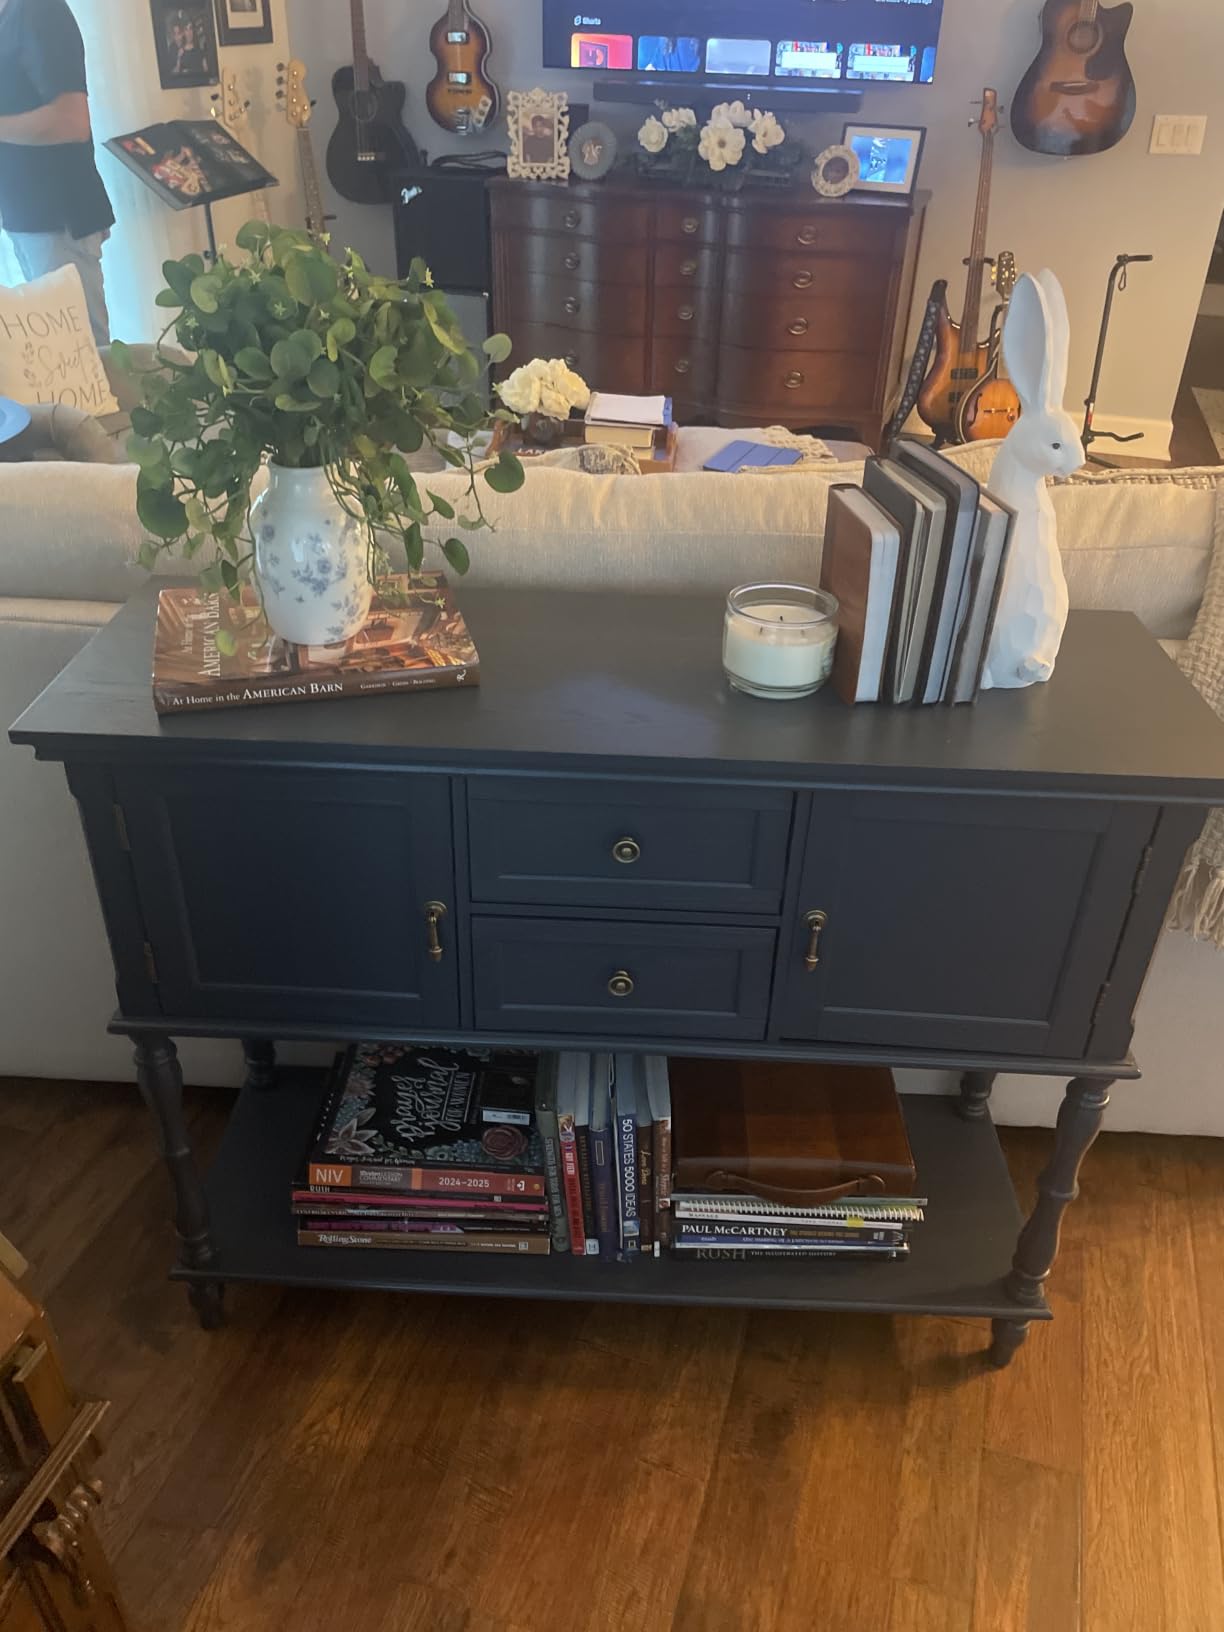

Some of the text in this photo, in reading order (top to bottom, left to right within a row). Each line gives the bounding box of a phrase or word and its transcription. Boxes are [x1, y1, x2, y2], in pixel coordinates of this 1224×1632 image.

[0, 305, 82, 339] HOME
[37, 338, 94, 386] Sweet
[36, 380, 108, 409] HOME
[172, 681, 344, 706] At Home in the AMERICAN BARN
[315, 1168, 344, 1183] NIV
[622, 1119, 636, 1217] 50 STATES 5000 IDEAS
[438, 1176, 490, 1188] 2024-2025
[682, 1224, 712, 1234] PAUL
[714, 1225, 788, 1237] McCARTNEY
[696, 1247, 747, 1261] RUSH
